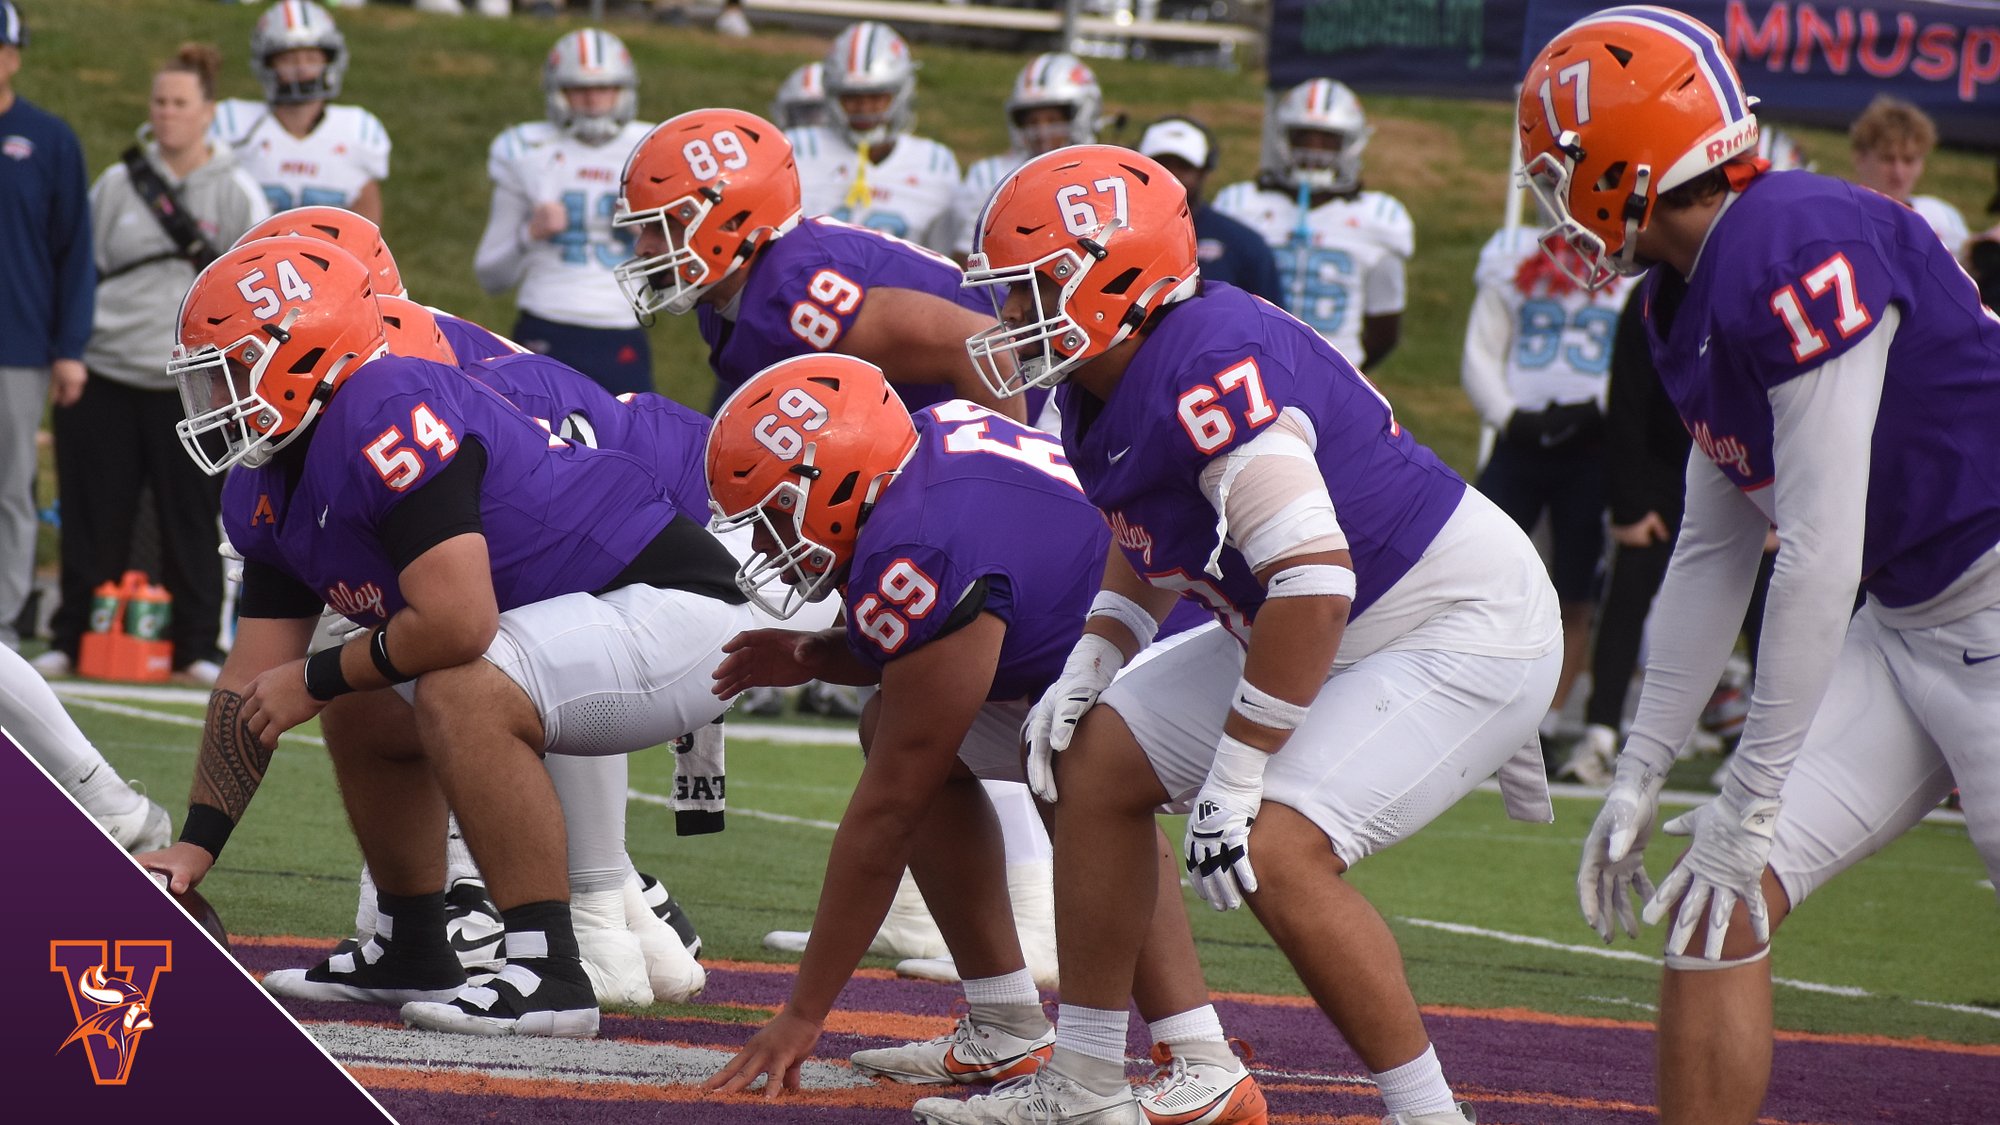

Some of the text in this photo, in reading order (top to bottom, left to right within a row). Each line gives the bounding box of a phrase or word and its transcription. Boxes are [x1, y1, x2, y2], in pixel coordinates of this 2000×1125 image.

[1538, 58, 1592, 138] 17
[682, 130, 749, 181] 89
[1056, 176, 1128, 237] 67
[236, 259, 313, 320] 54
[789, 268, 864, 351] 89
[1769, 251, 1873, 364] 17
[753, 388, 829, 461] 69
[1177, 355, 1279, 456] 67
[361, 402, 460, 493] 54
[853, 558, 939, 654] 69
